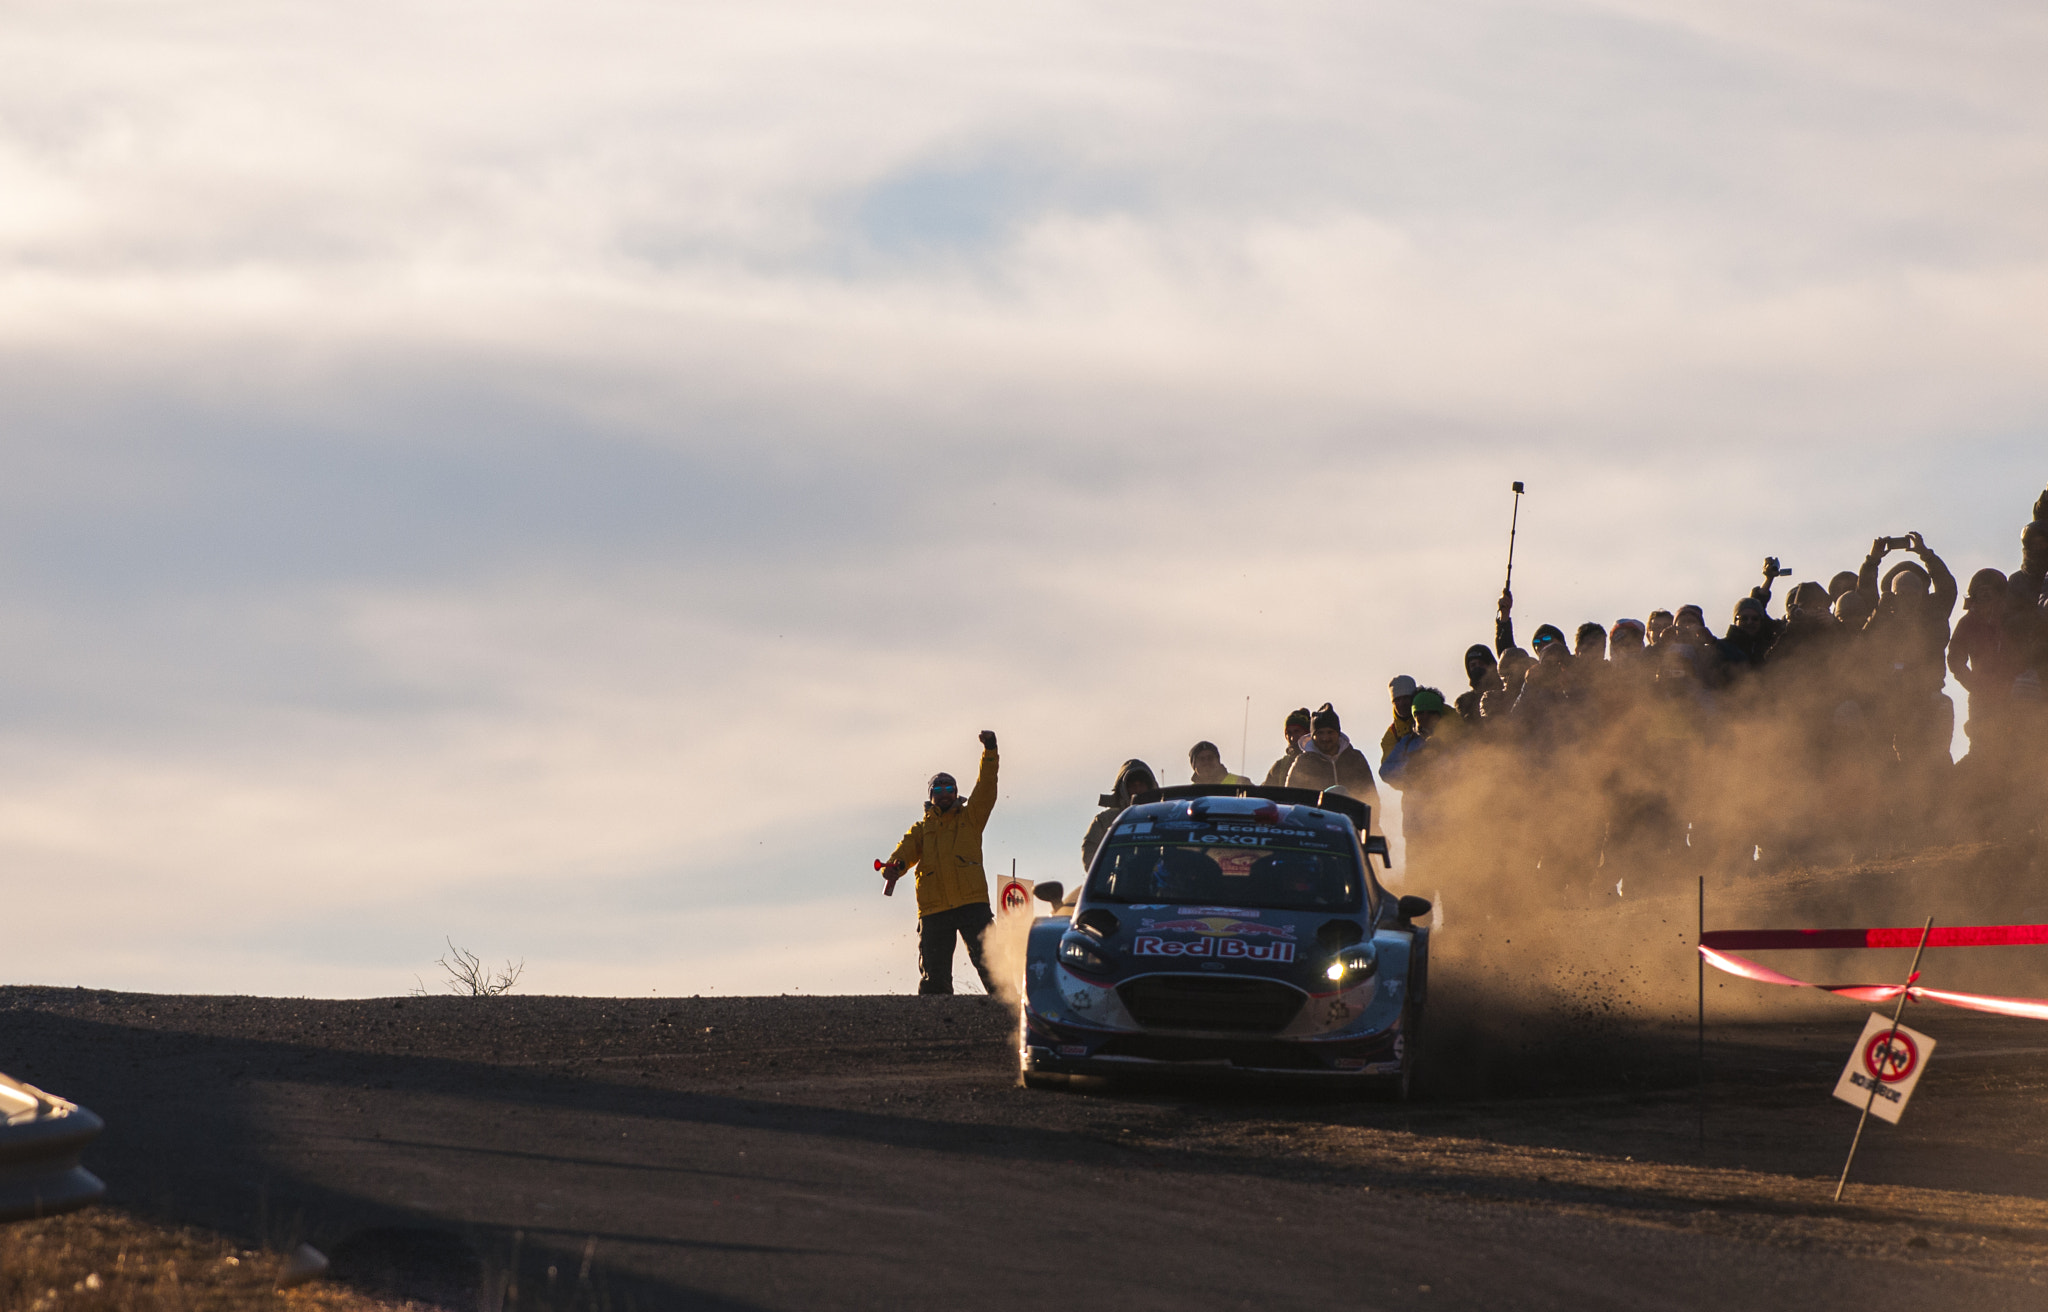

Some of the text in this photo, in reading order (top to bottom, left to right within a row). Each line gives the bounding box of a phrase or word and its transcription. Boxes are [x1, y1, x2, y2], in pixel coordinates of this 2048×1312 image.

[1216, 824, 1316, 838] EcoBoost
[1188, 832, 1272, 846] Lexar
[1134, 936, 1295, 962] Red Bull
